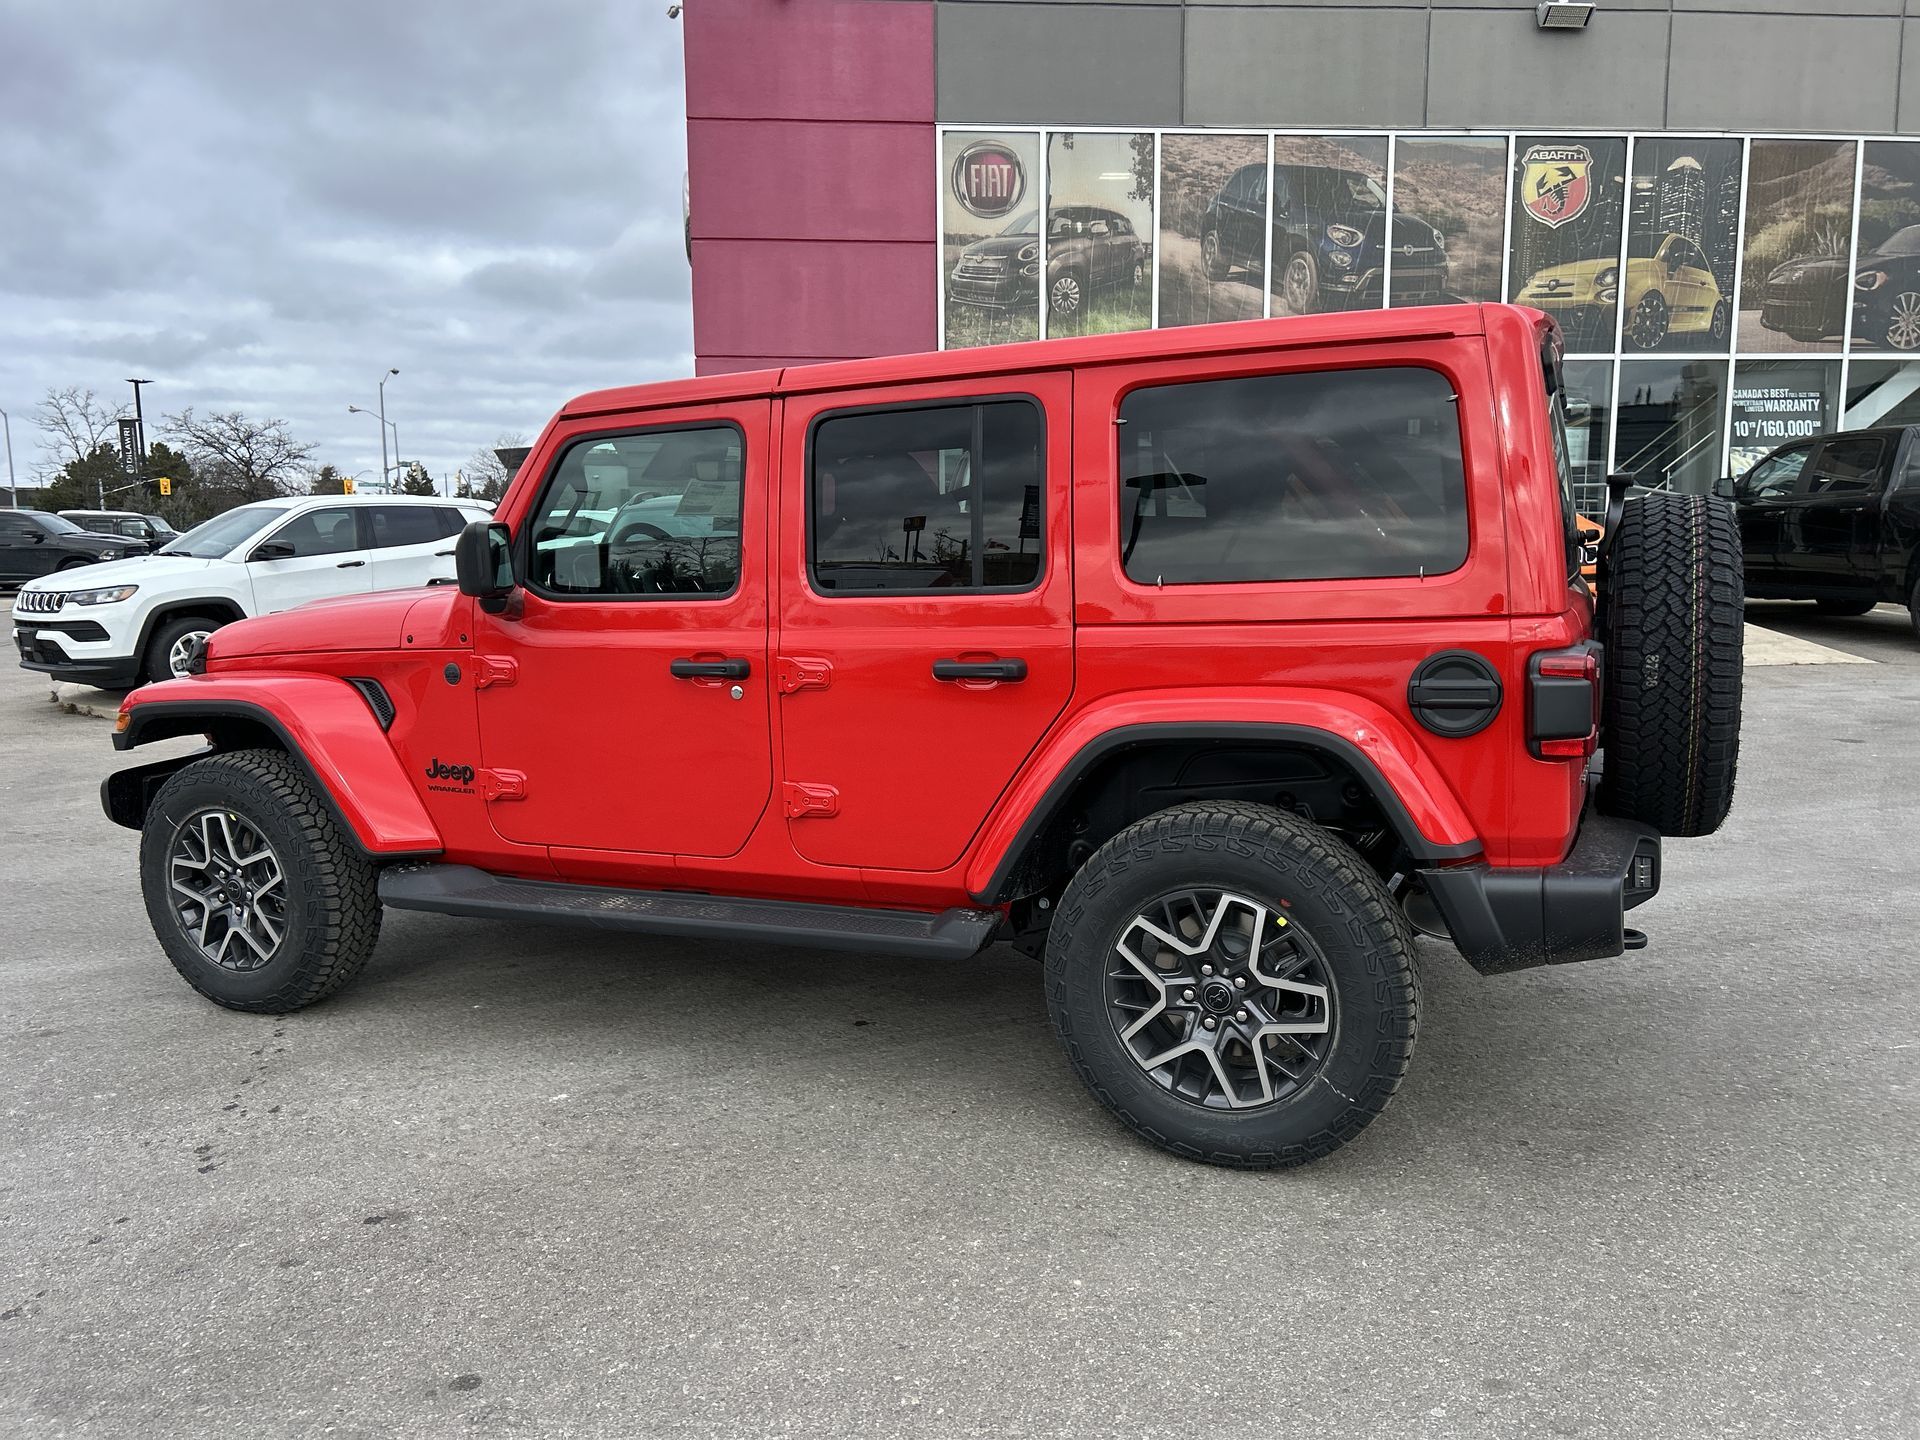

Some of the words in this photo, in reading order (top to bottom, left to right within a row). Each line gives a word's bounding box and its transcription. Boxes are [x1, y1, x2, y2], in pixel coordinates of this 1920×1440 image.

[1529, 151, 1584, 160] ABARTH
[970, 164, 1012, 198] FIAT
[1733, 389, 1769, 399] CANADA'S
[1770, 388, 1789, 398] BEST
[1764, 399, 1820, 412] WARRANTY
[123, 427, 133, 464] DILAWRI
[425, 757, 475, 785] Jeep
[427, 784, 475, 794] WRANGLER
